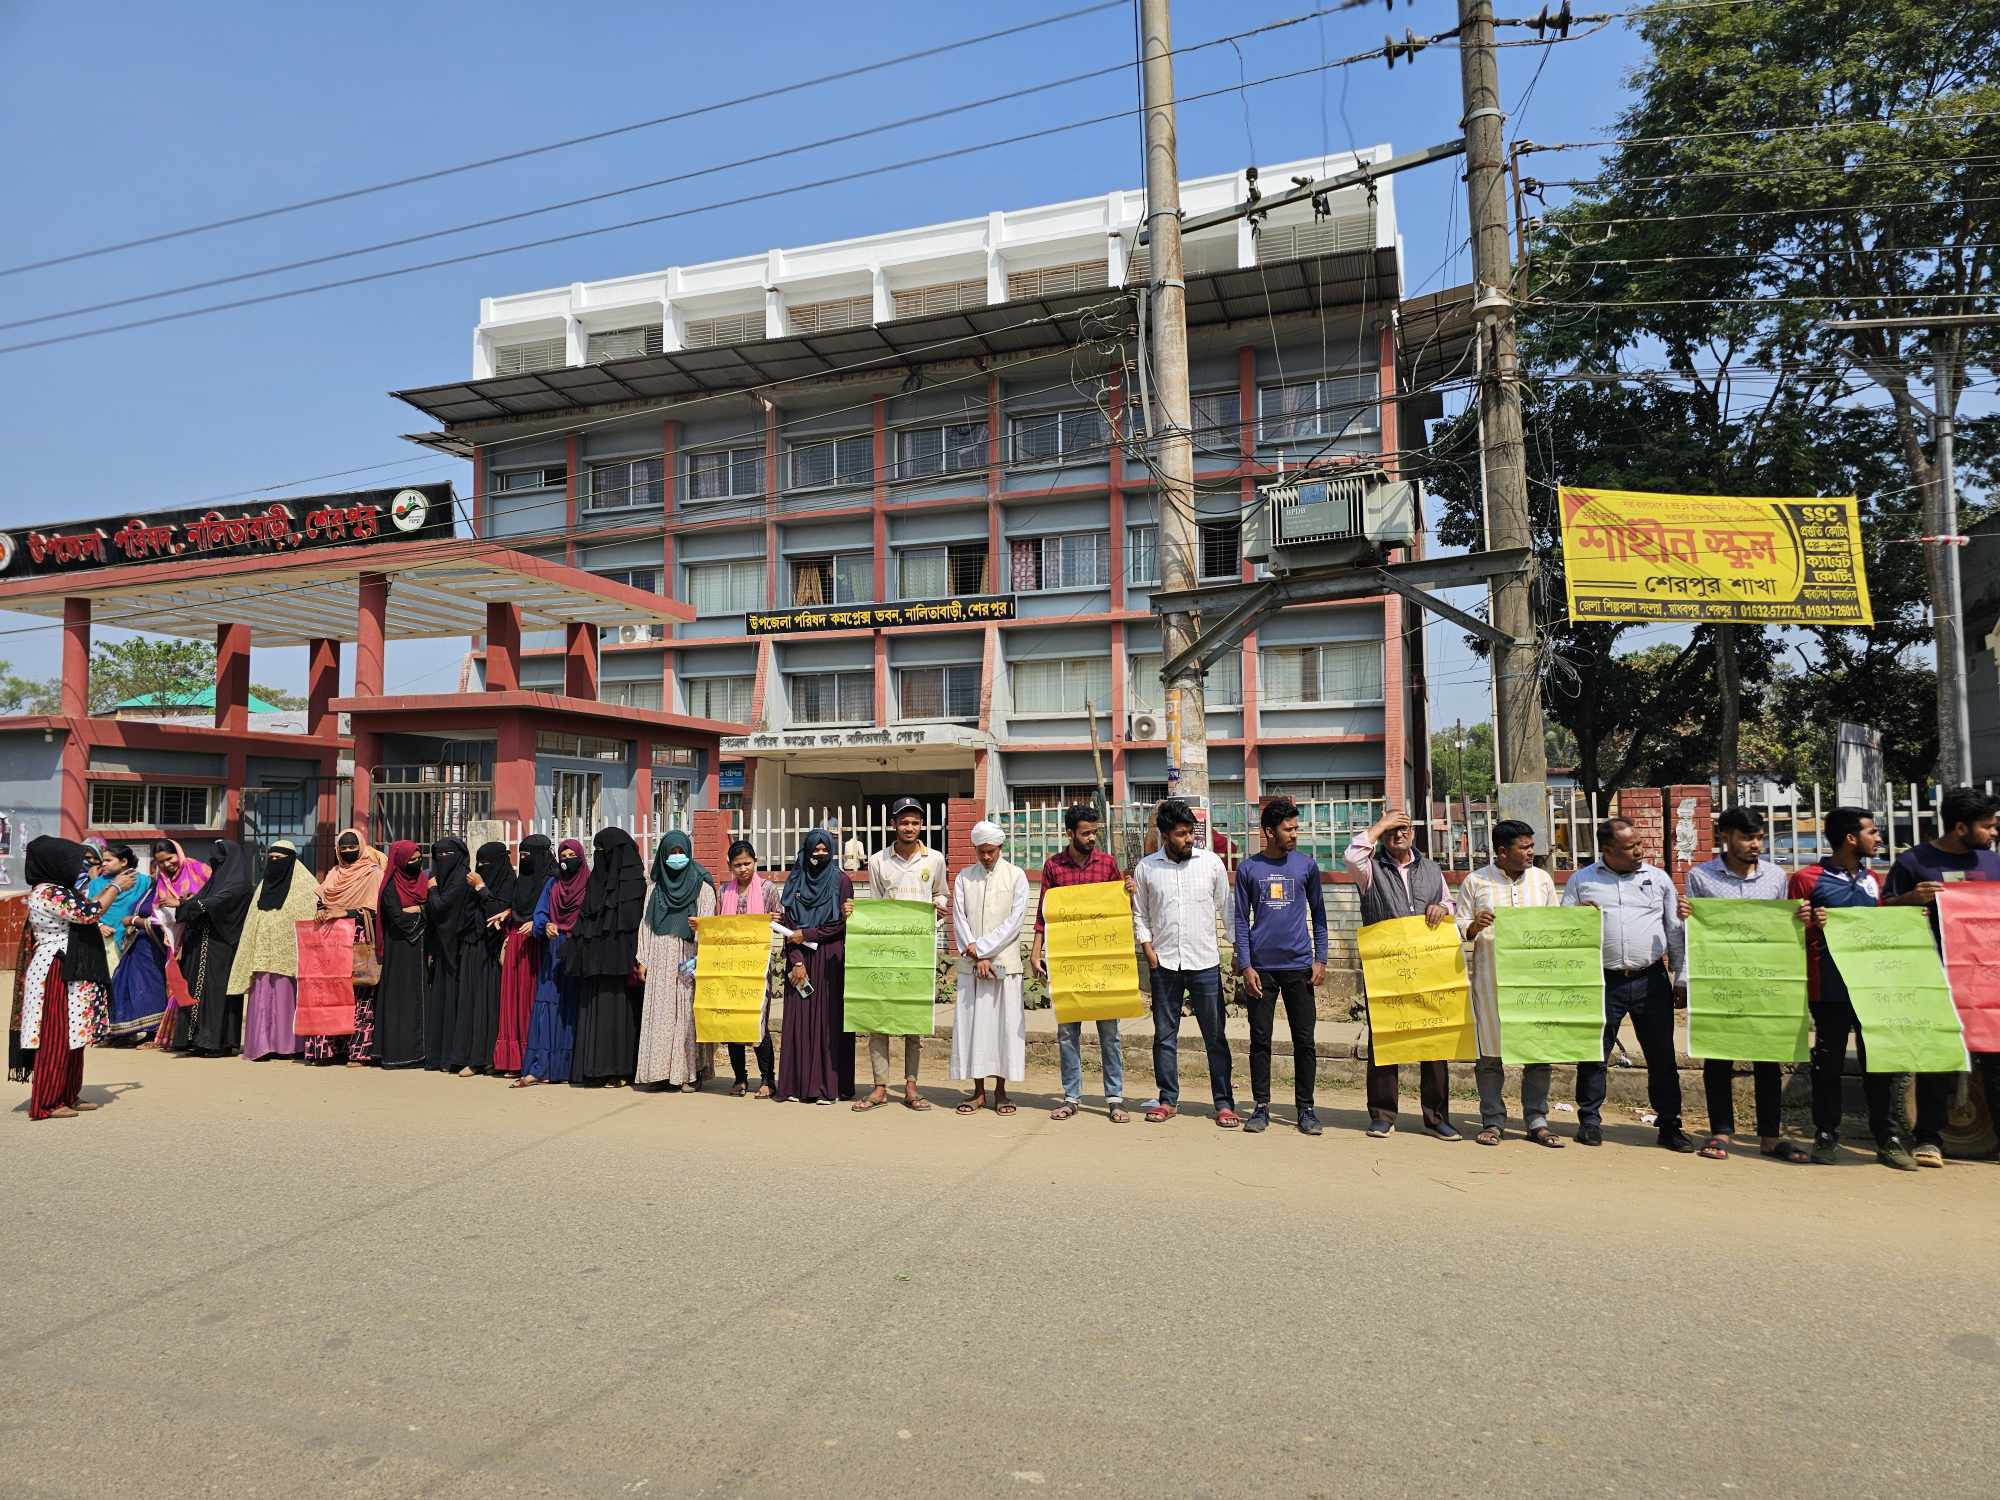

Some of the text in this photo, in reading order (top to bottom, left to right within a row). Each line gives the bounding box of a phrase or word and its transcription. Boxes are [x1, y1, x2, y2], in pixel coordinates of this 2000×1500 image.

[1801, 506, 1838, 522] SSC
[27, 528, 107, 565] উপজেলা
[306, 502, 383, 541] শেরপুর
[1576, 518, 1777, 569] শাহীন স্কুল
[1805, 553, 1851, 568] ক্যাডেট
[1813, 569, 1853, 583] কোচিং
[1645, 575, 1776, 598] শেরপুর শাখা
[749, 615, 792, 630] উপজেলা
[794, 611, 826, 628] পরিষদ
[830, 610, 871, 626] কমপ্লেক্স
[874, 609, 903, 625] ভবন,
[905, 600, 967, 621] নালিতাবাড়ী,
[1579, 600, 1601, 612] জেলা
